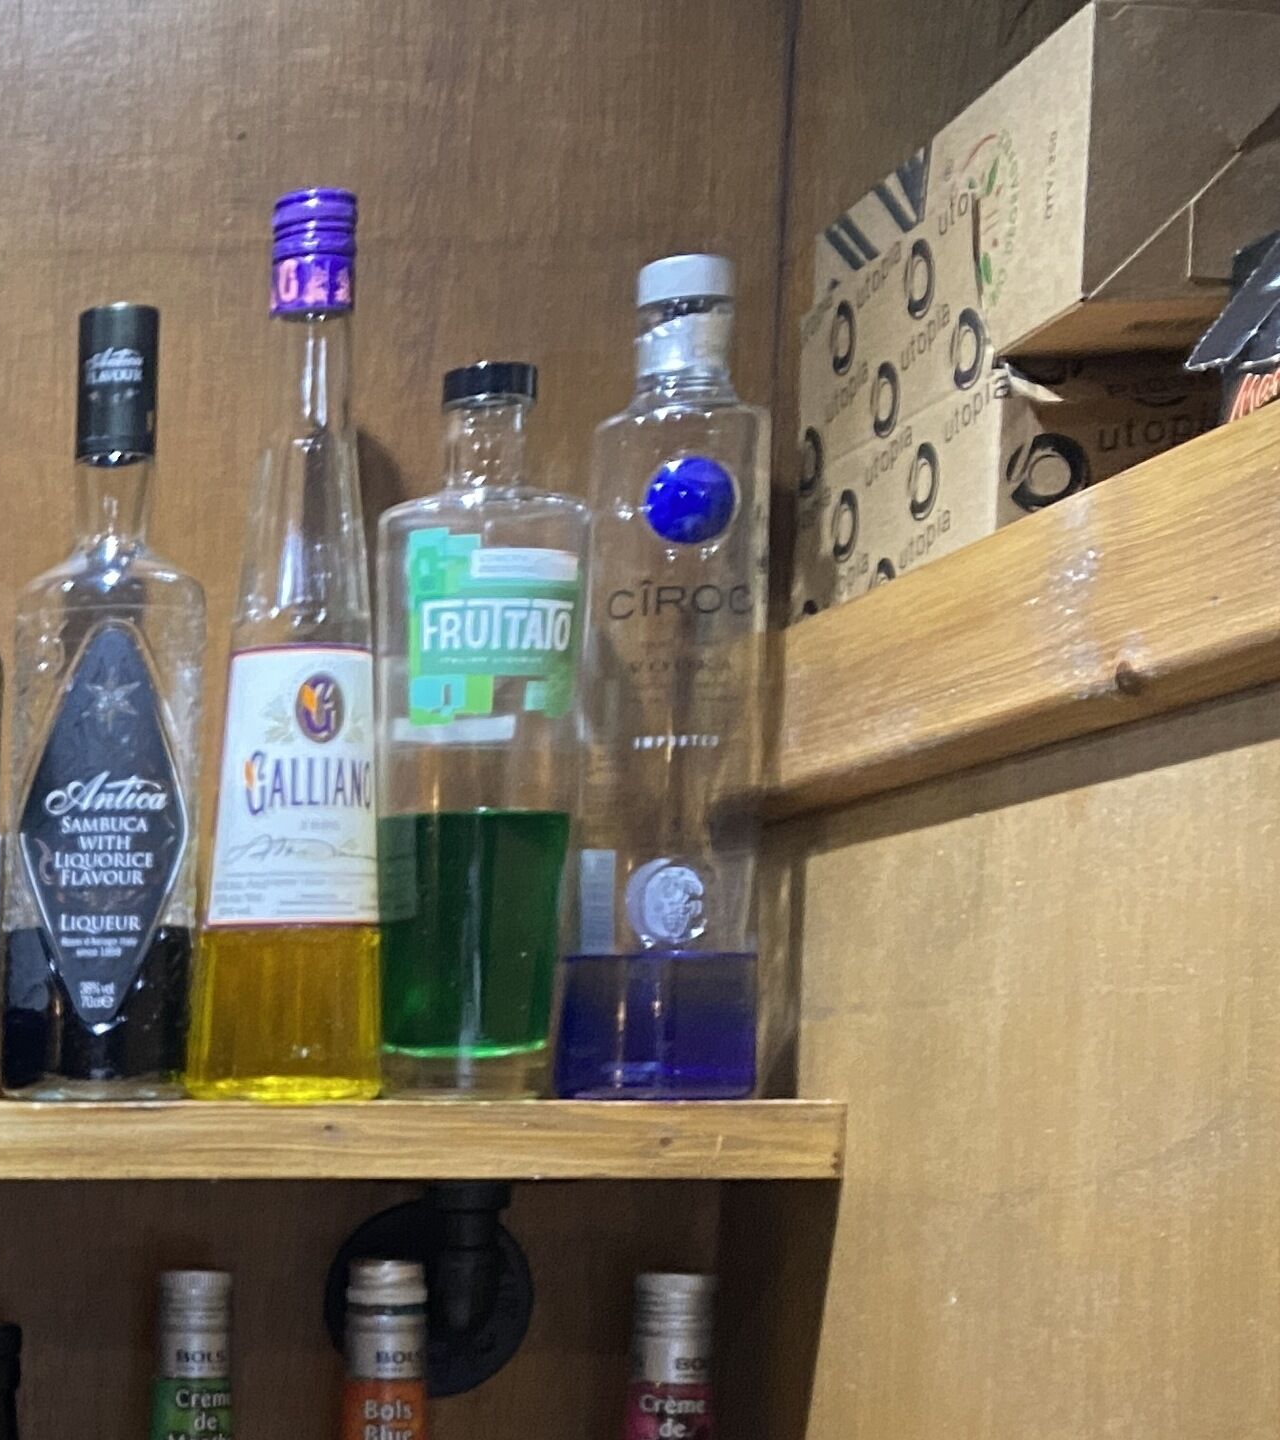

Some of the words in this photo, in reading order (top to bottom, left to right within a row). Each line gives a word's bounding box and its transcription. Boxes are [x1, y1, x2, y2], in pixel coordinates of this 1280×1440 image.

[943, 374, 1013, 442] utopia
[865, 425, 913, 487] utopia
[899, 509, 952, 579] utopia
[420, 597, 575, 652] FRUTTATO
[44, 770, 169, 816] Antica
[244, 750, 373, 816] GALLIANO
[60, 815, 149, 834] SAMBUCA
[78, 834, 132, 851] WITH
[53, 851, 155, 871] LIQUORICE
[61, 869, 145, 887] FLAVOUR
[59, 913, 143, 934] LIQUEUR
[363, 1399, 414, 1421] Bols
[192, 1411, 219, 1432] de
[659, 1418, 688, 1438] de
